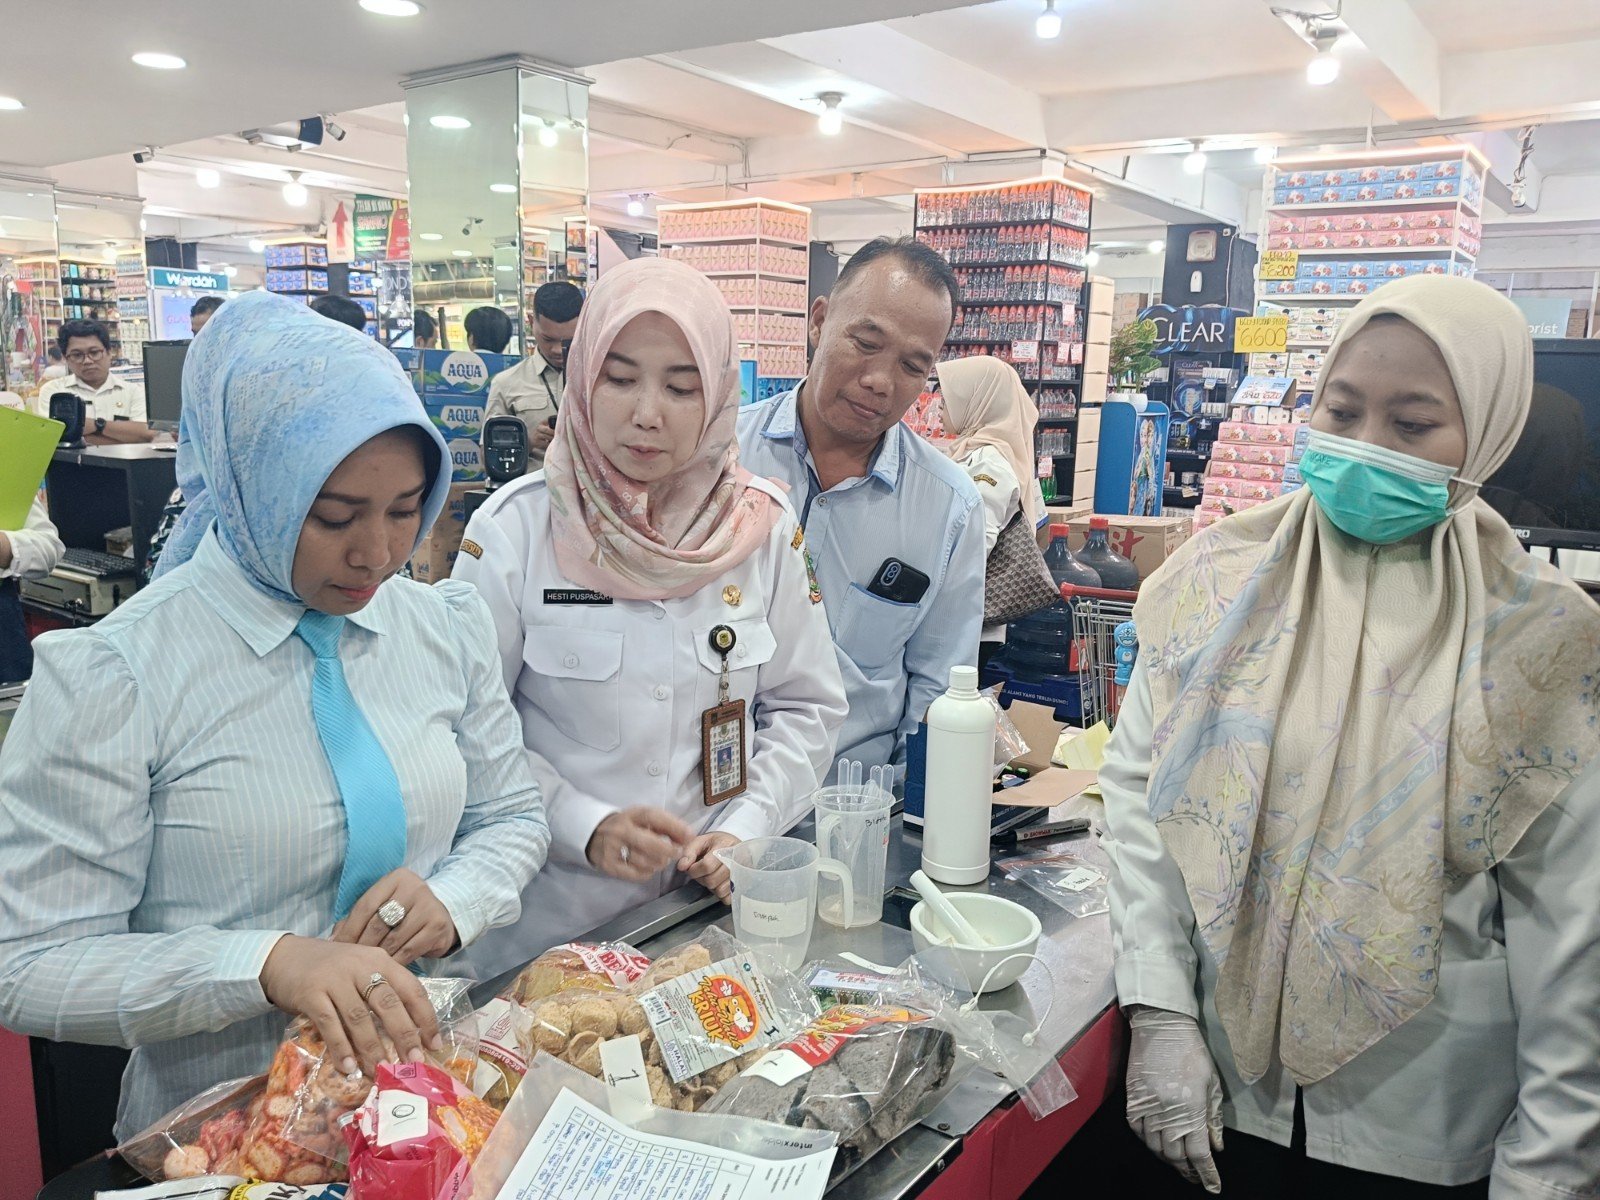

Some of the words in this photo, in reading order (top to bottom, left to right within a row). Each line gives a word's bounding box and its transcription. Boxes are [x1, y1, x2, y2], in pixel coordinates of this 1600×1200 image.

[1152, 317, 1225, 343] CLEAR
[447, 363, 482, 379] AQUA
[447, 408, 480, 424] AQUA
[687, 989, 725, 1043] KRIUK
[673, 1049, 688, 1074] HALAL
